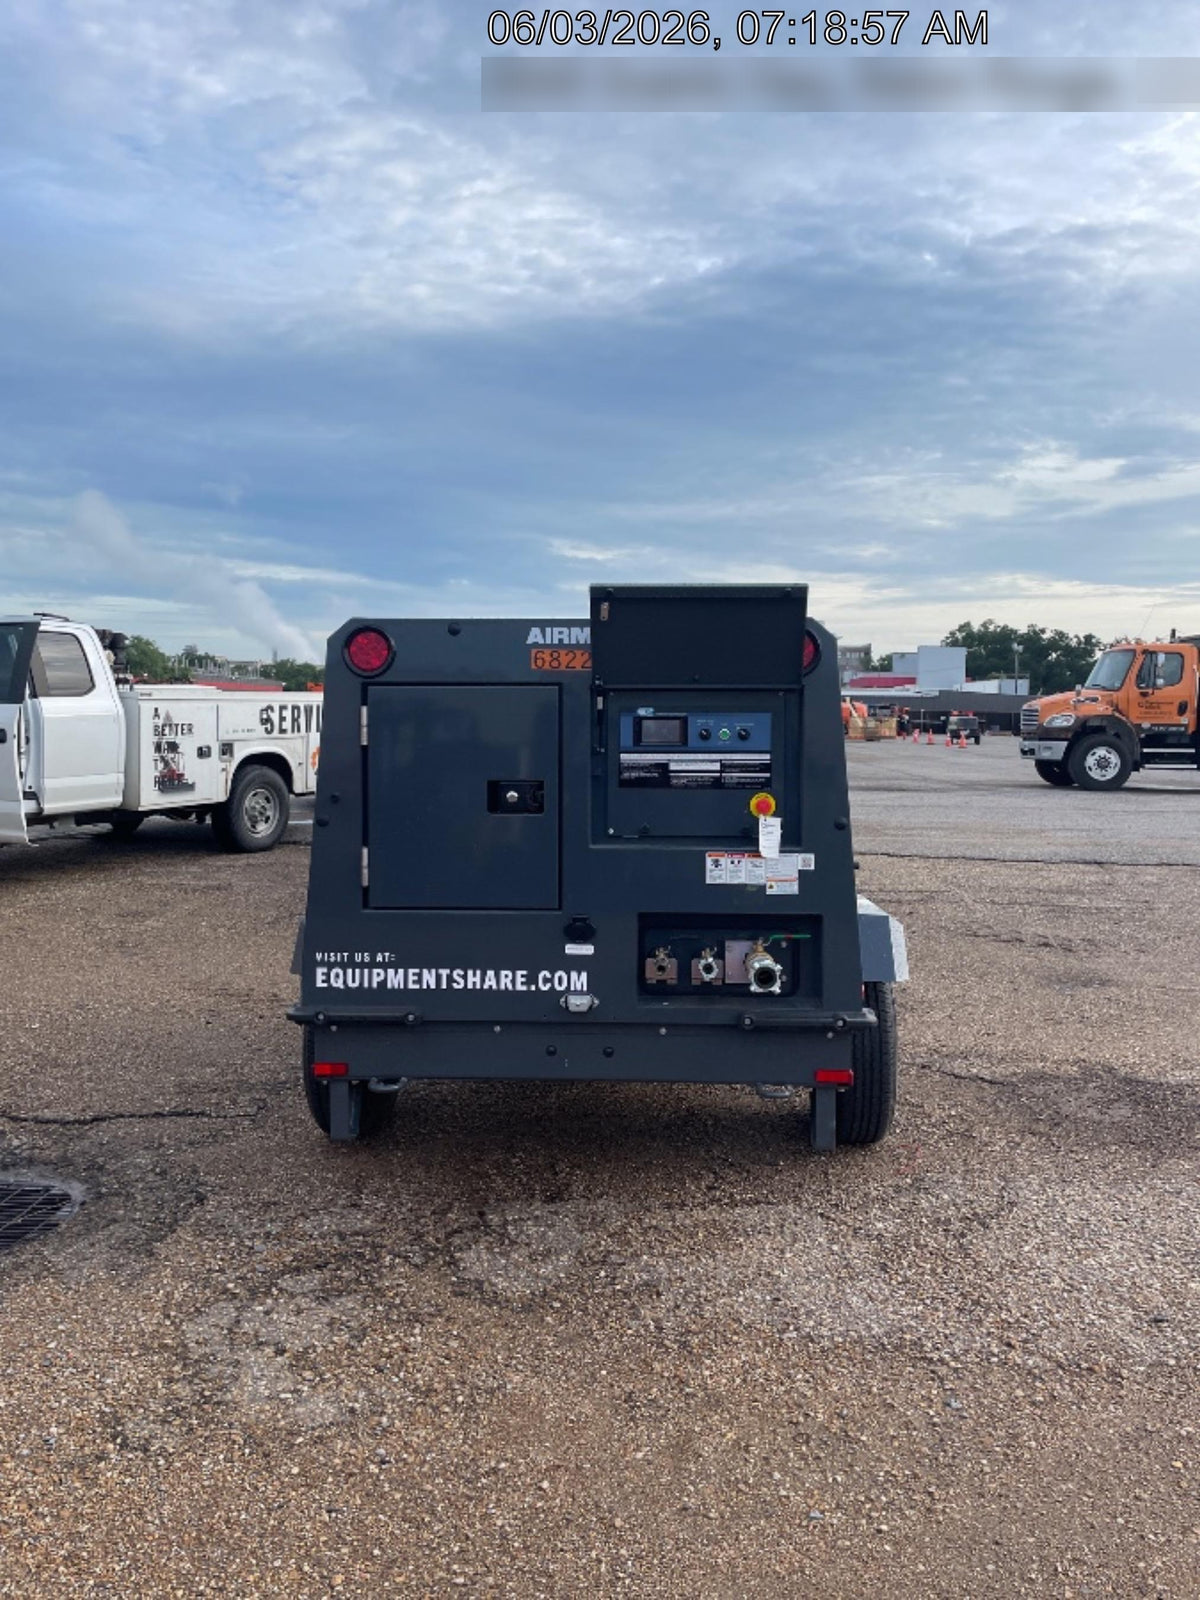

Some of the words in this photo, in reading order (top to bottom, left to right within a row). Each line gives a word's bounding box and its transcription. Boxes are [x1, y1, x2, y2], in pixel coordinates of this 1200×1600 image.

[526, 626, 591, 645] AIRM
[534, 650, 592, 669] 6822
[152, 707, 160, 721] A
[153, 723, 194, 737] BETTER
[315, 952, 349, 963] VISIT
[354, 952, 371, 963] US
[315, 966, 588, 992] EQUIPMENTSHARE.COM
